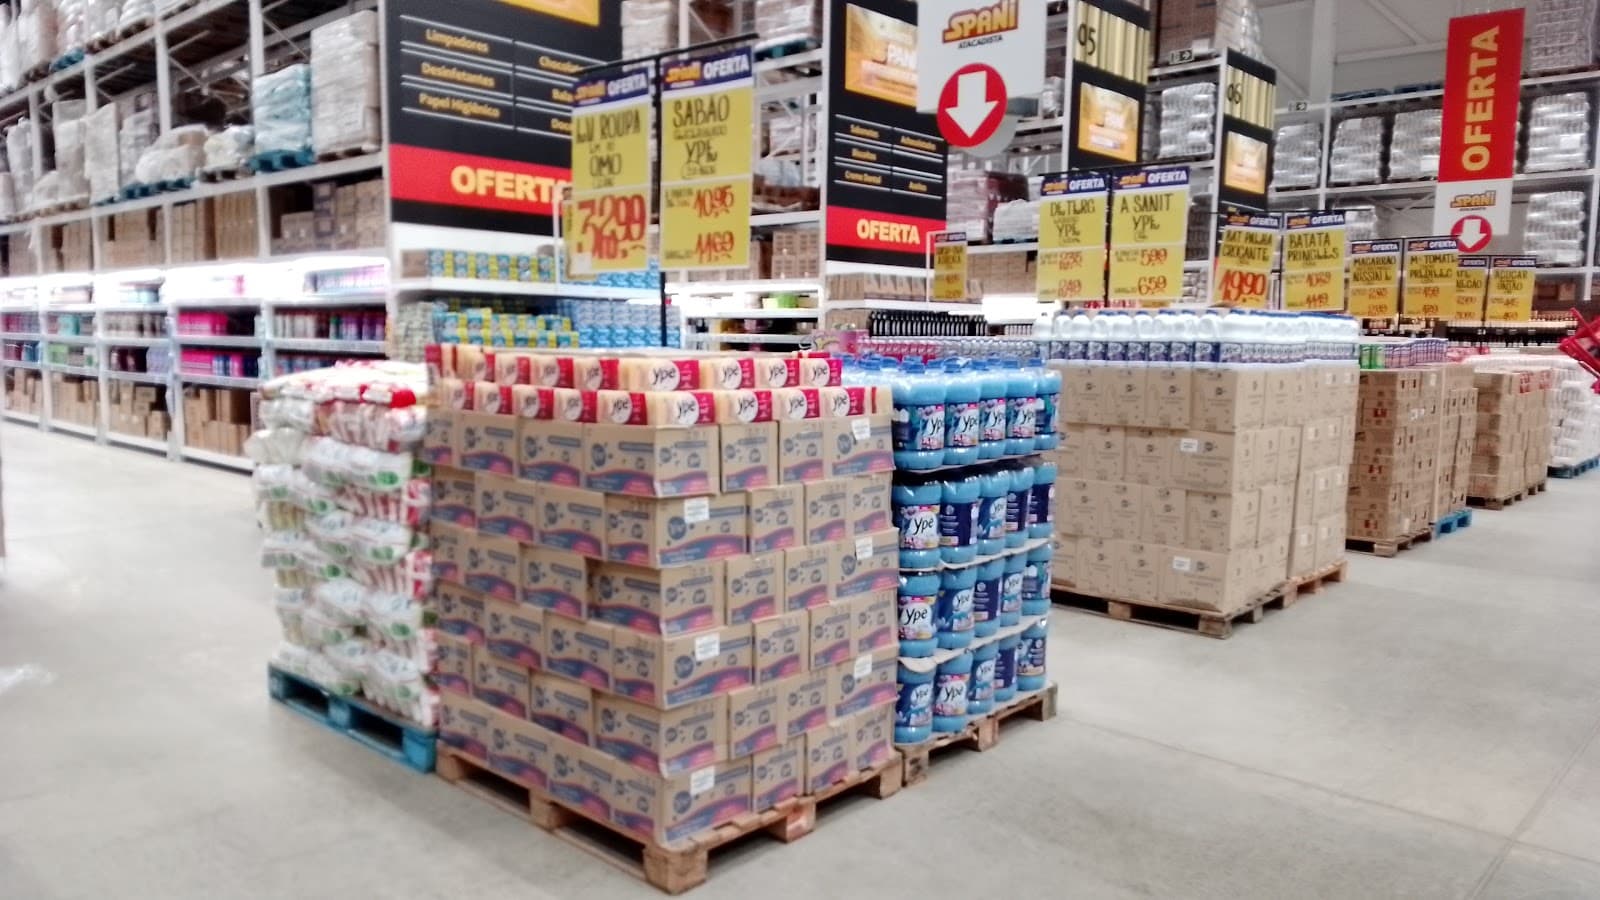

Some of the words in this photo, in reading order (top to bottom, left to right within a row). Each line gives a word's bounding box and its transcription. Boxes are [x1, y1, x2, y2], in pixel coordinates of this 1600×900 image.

[943, 0, 1018, 42] SPANI
[1076, 23, 1096, 56] 05
[703, 54, 750, 80] OFERTA
[607, 72, 649, 97] OFERTA
[1462, 25, 1499, 172] OFERTA
[450, 165, 568, 204] OFERT
[1069, 177, 1105, 191] OFERTA
[1147, 170, 1188, 184] OFERTA
[856, 218, 921, 244] OFERTA
[1249, 215, 1279, 227] OFERTA
[1311, 214, 1345, 225] OFERTA
